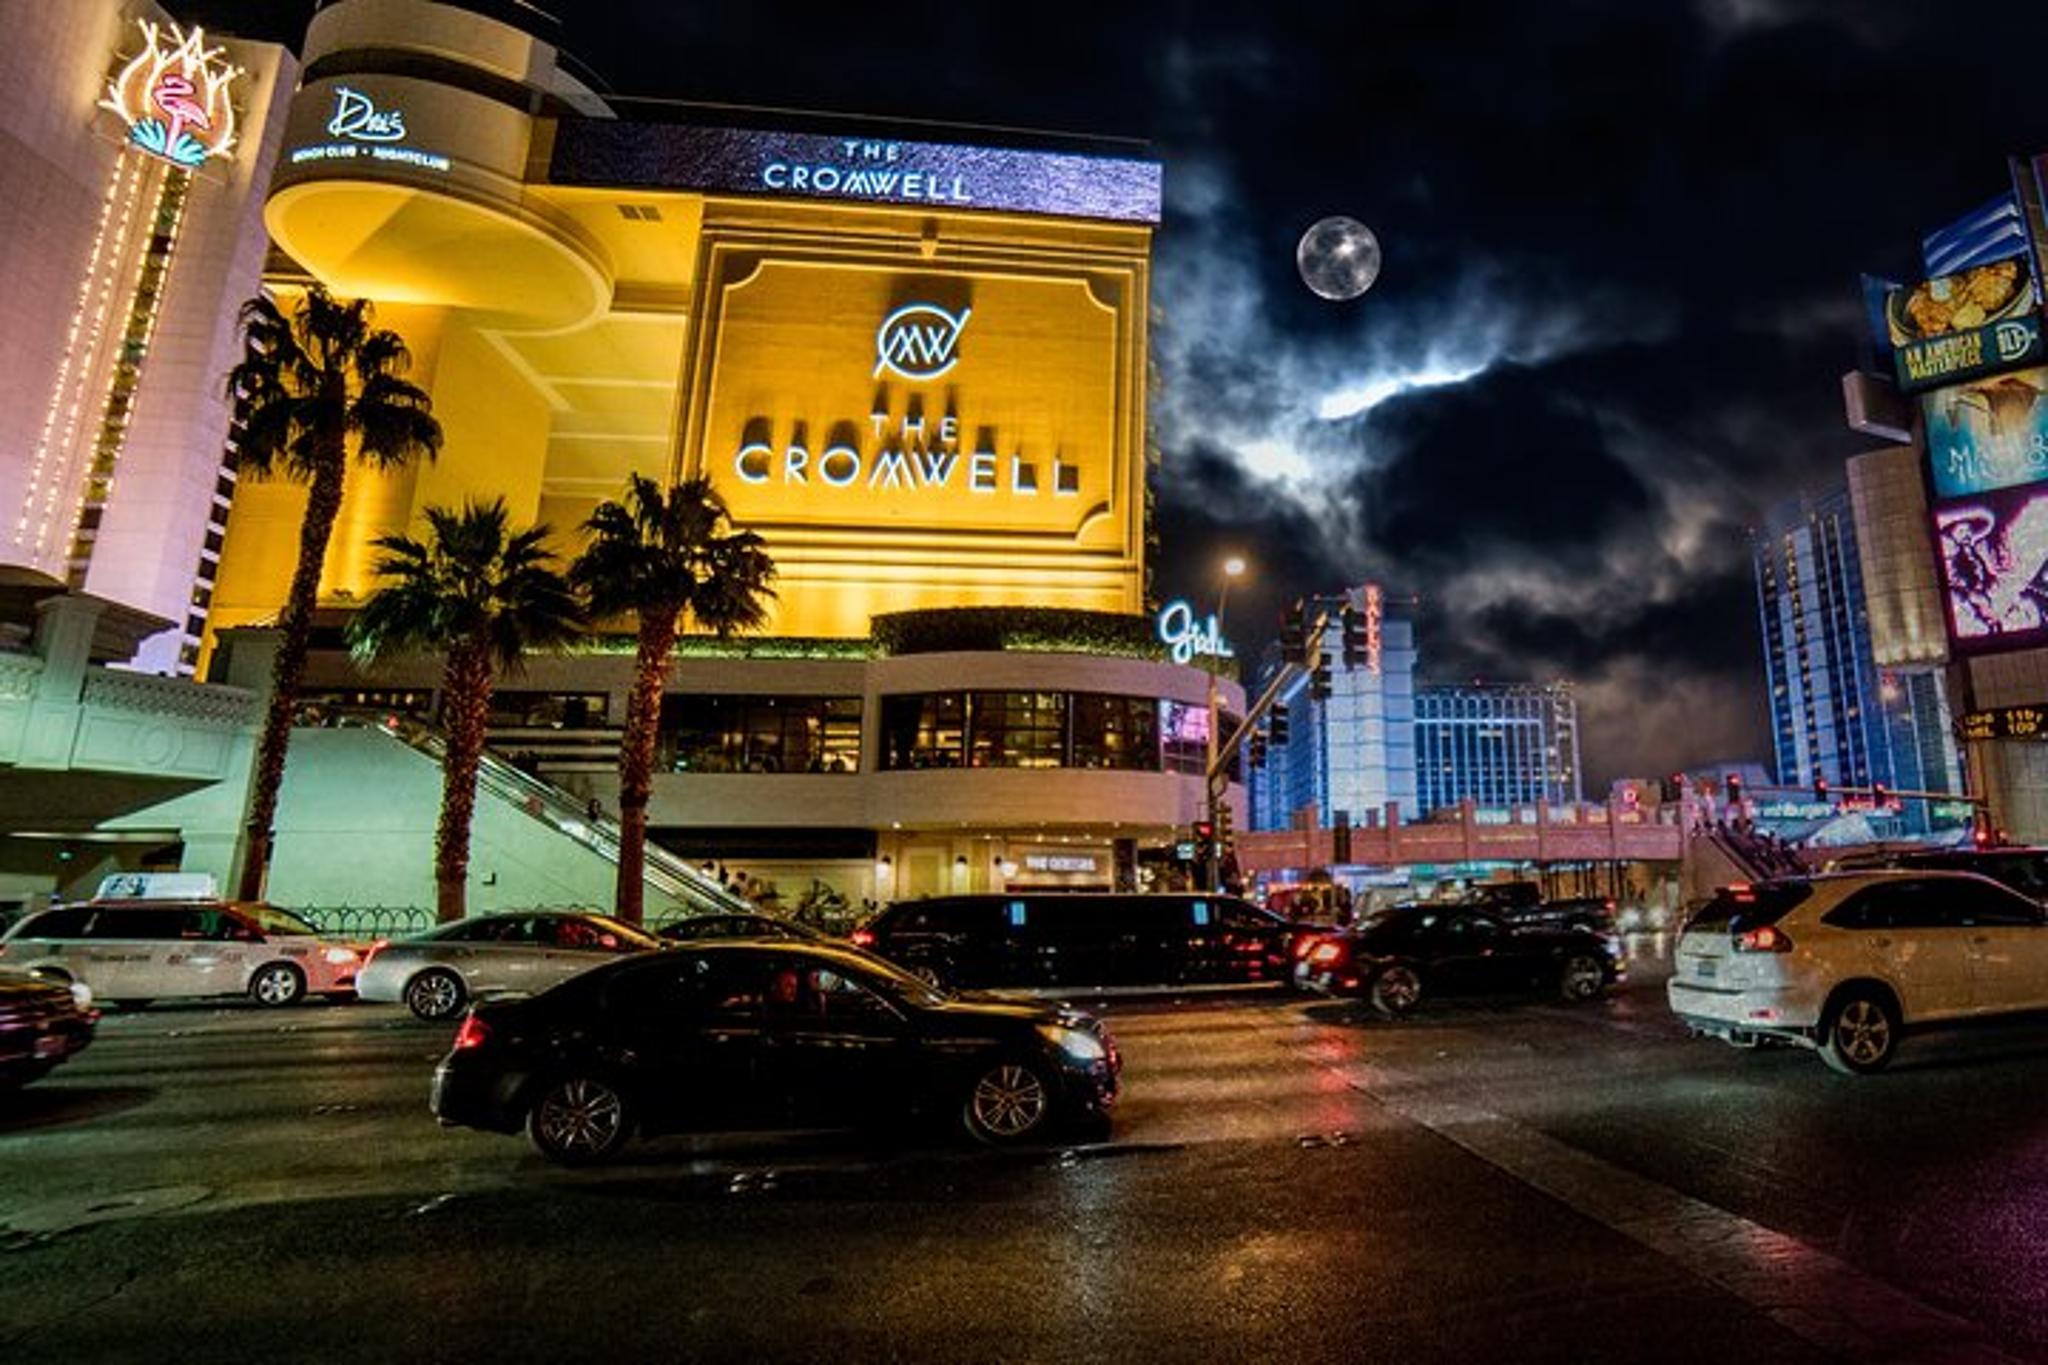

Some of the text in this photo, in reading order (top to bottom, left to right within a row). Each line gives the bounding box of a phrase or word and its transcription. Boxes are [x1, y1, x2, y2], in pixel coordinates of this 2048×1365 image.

[844, 140, 902, 161] THE
[763, 163, 974, 201] CROMWELL
[870, 413, 958, 442] THE
[735, 445, 1080, 497] CROMWELL
